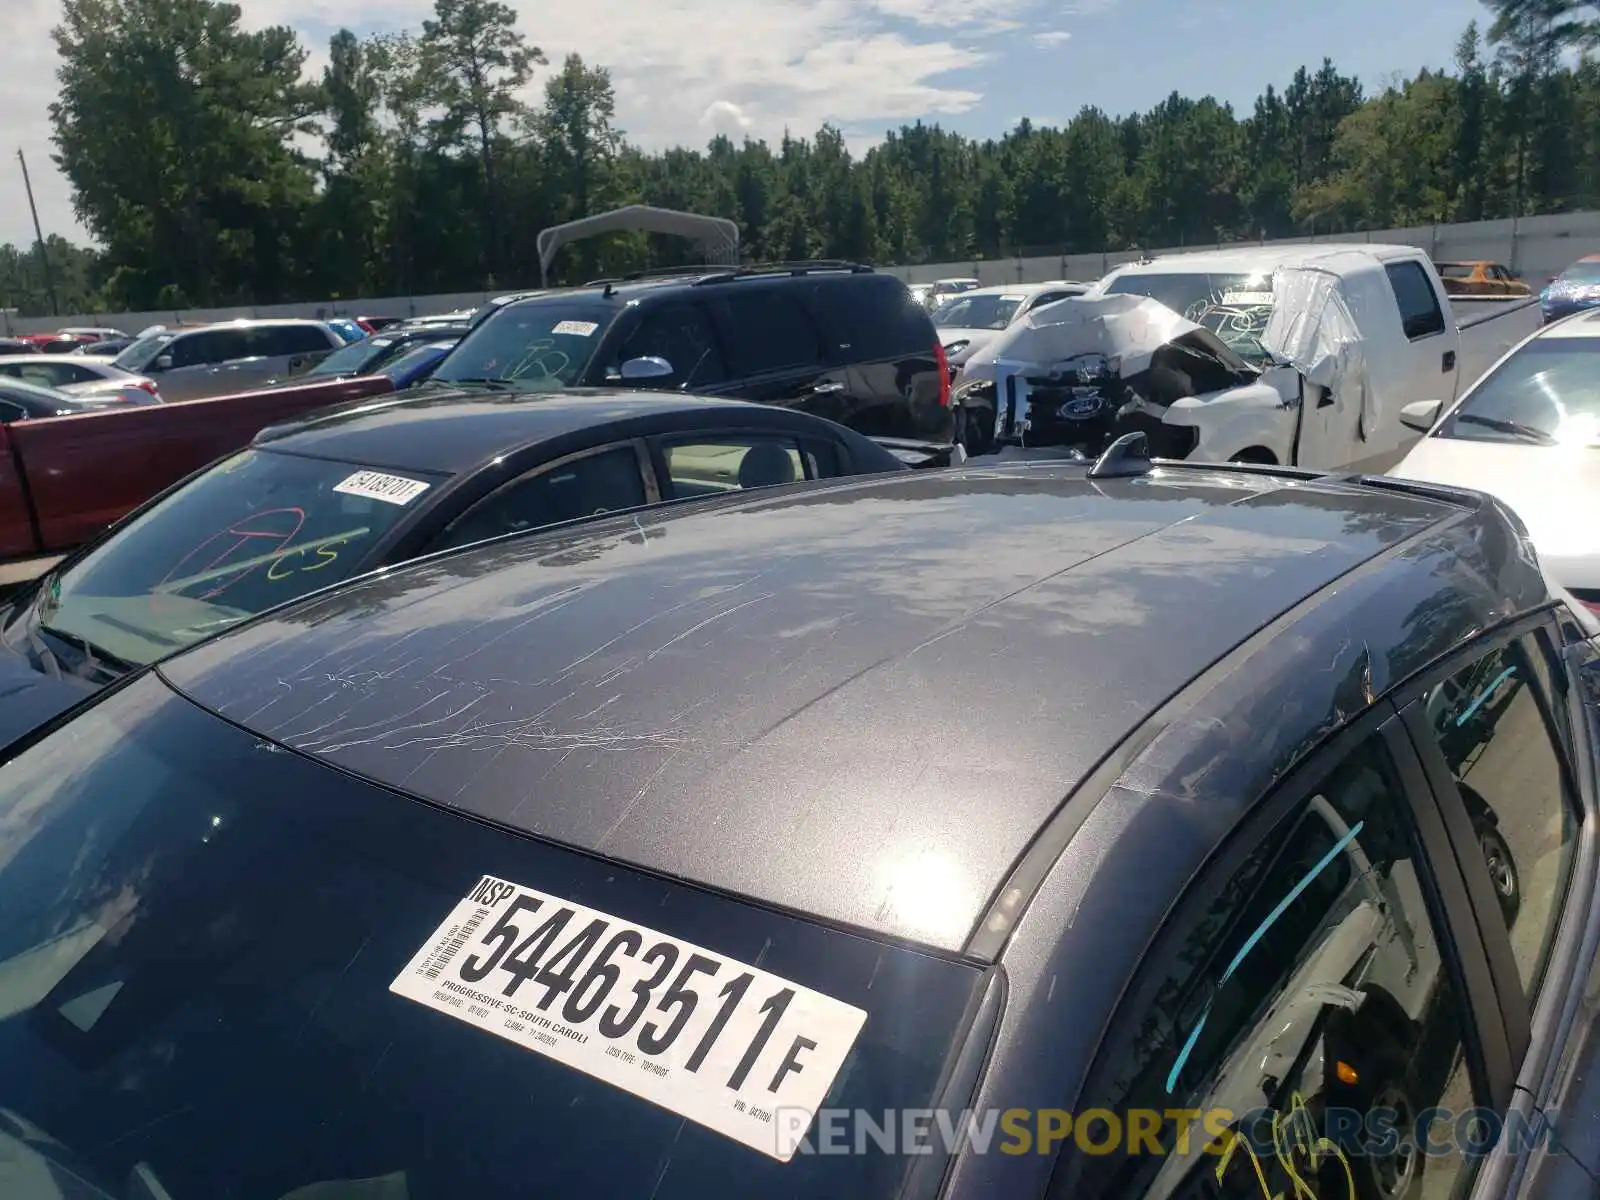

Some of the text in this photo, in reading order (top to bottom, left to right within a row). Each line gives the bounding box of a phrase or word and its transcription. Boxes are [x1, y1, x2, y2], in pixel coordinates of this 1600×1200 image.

[469, 877, 515, 907] NSP
[458, 893, 818, 1094] 54463511 F
[551, 1023, 590, 1044] CAROLI
